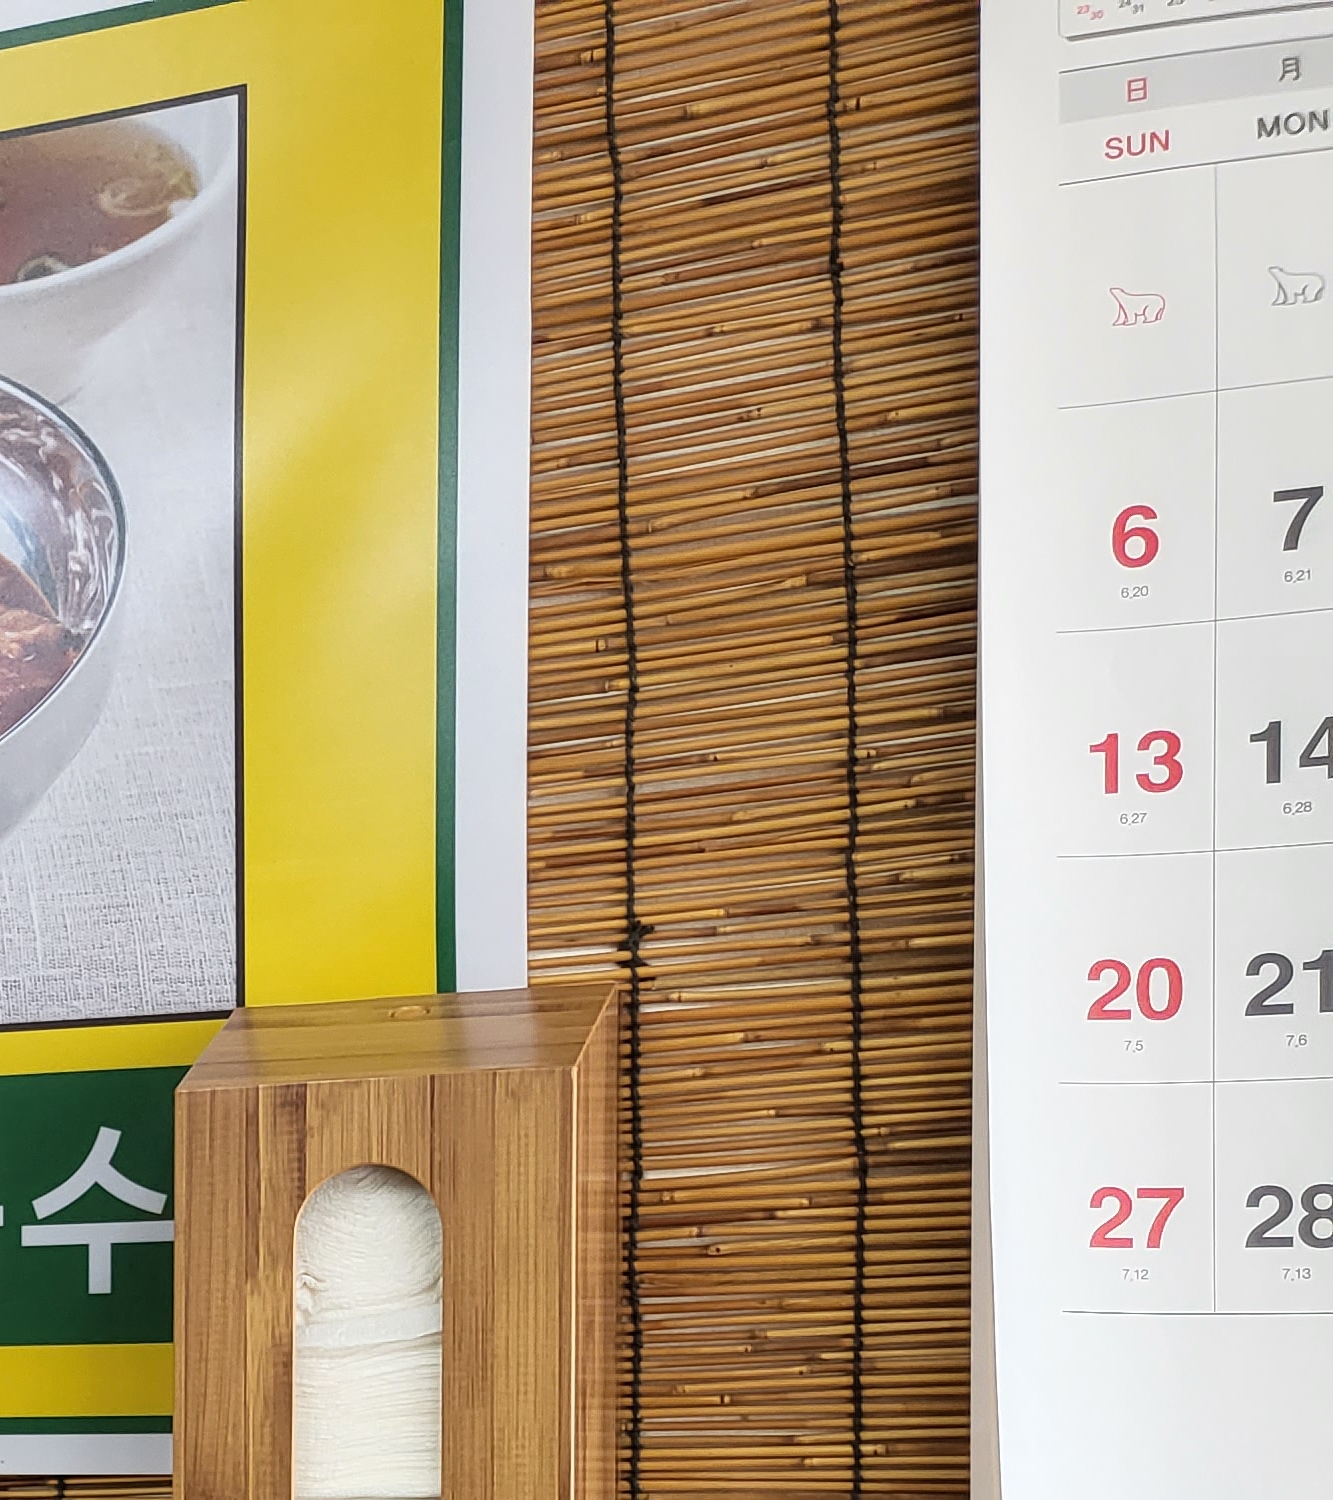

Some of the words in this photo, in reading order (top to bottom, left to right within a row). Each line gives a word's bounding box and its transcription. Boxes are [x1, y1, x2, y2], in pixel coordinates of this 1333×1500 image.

[1126, 77, 1149, 104] 日
[1279, 55, 1302, 83] 月
[1104, 129, 1171, 160] SUN
[1256, 108, 1332, 140] MON
[1111, 504, 1160, 569] 6
[1272, 485, 1325, 553] 7
[1088, 730, 1184, 795] 13
[1249, 715, 1333, 785] 14
[1086, 957, 1184, 1022] 20
[1244, 948, 1333, 1018] 21
[1088, 1185, 1186, 1249] 27
[1244, 1182, 1333, 1250] 28
